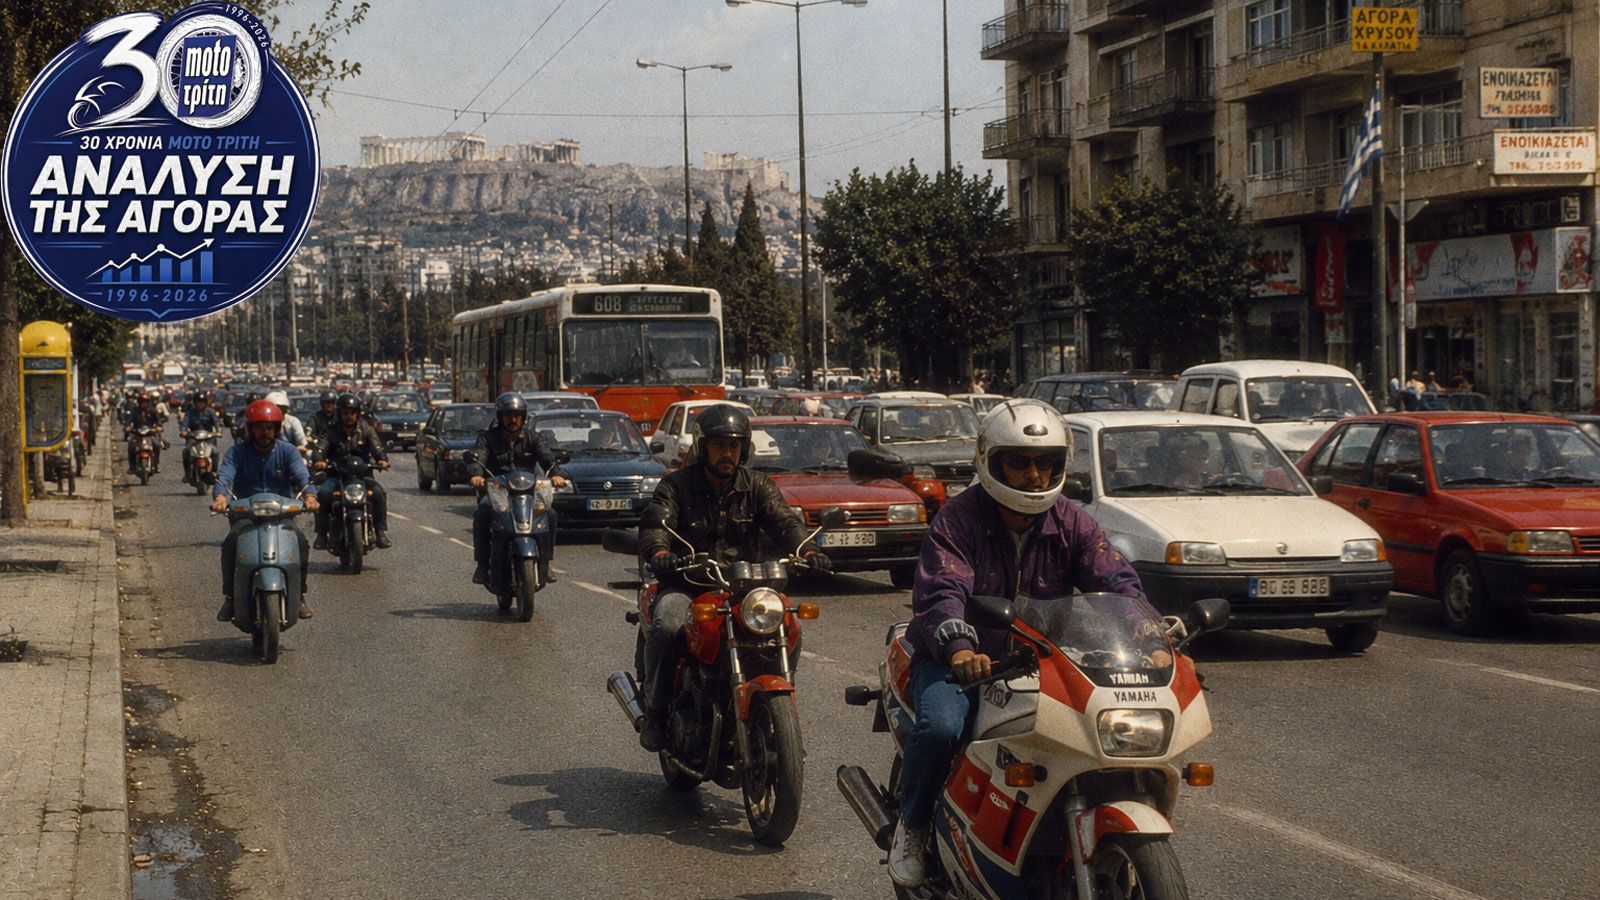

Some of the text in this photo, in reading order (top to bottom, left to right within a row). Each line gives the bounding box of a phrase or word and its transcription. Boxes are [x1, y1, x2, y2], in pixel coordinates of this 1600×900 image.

[1356, 10, 1411, 24] ΑΓΟΡΑ
[1501, 135, 1589, 148] ΕΝΟΙΚΙΑΖΕΤΑΙ
[594, 296, 622, 312] 608
[1114, 691, 1157, 702] YAMAHA
